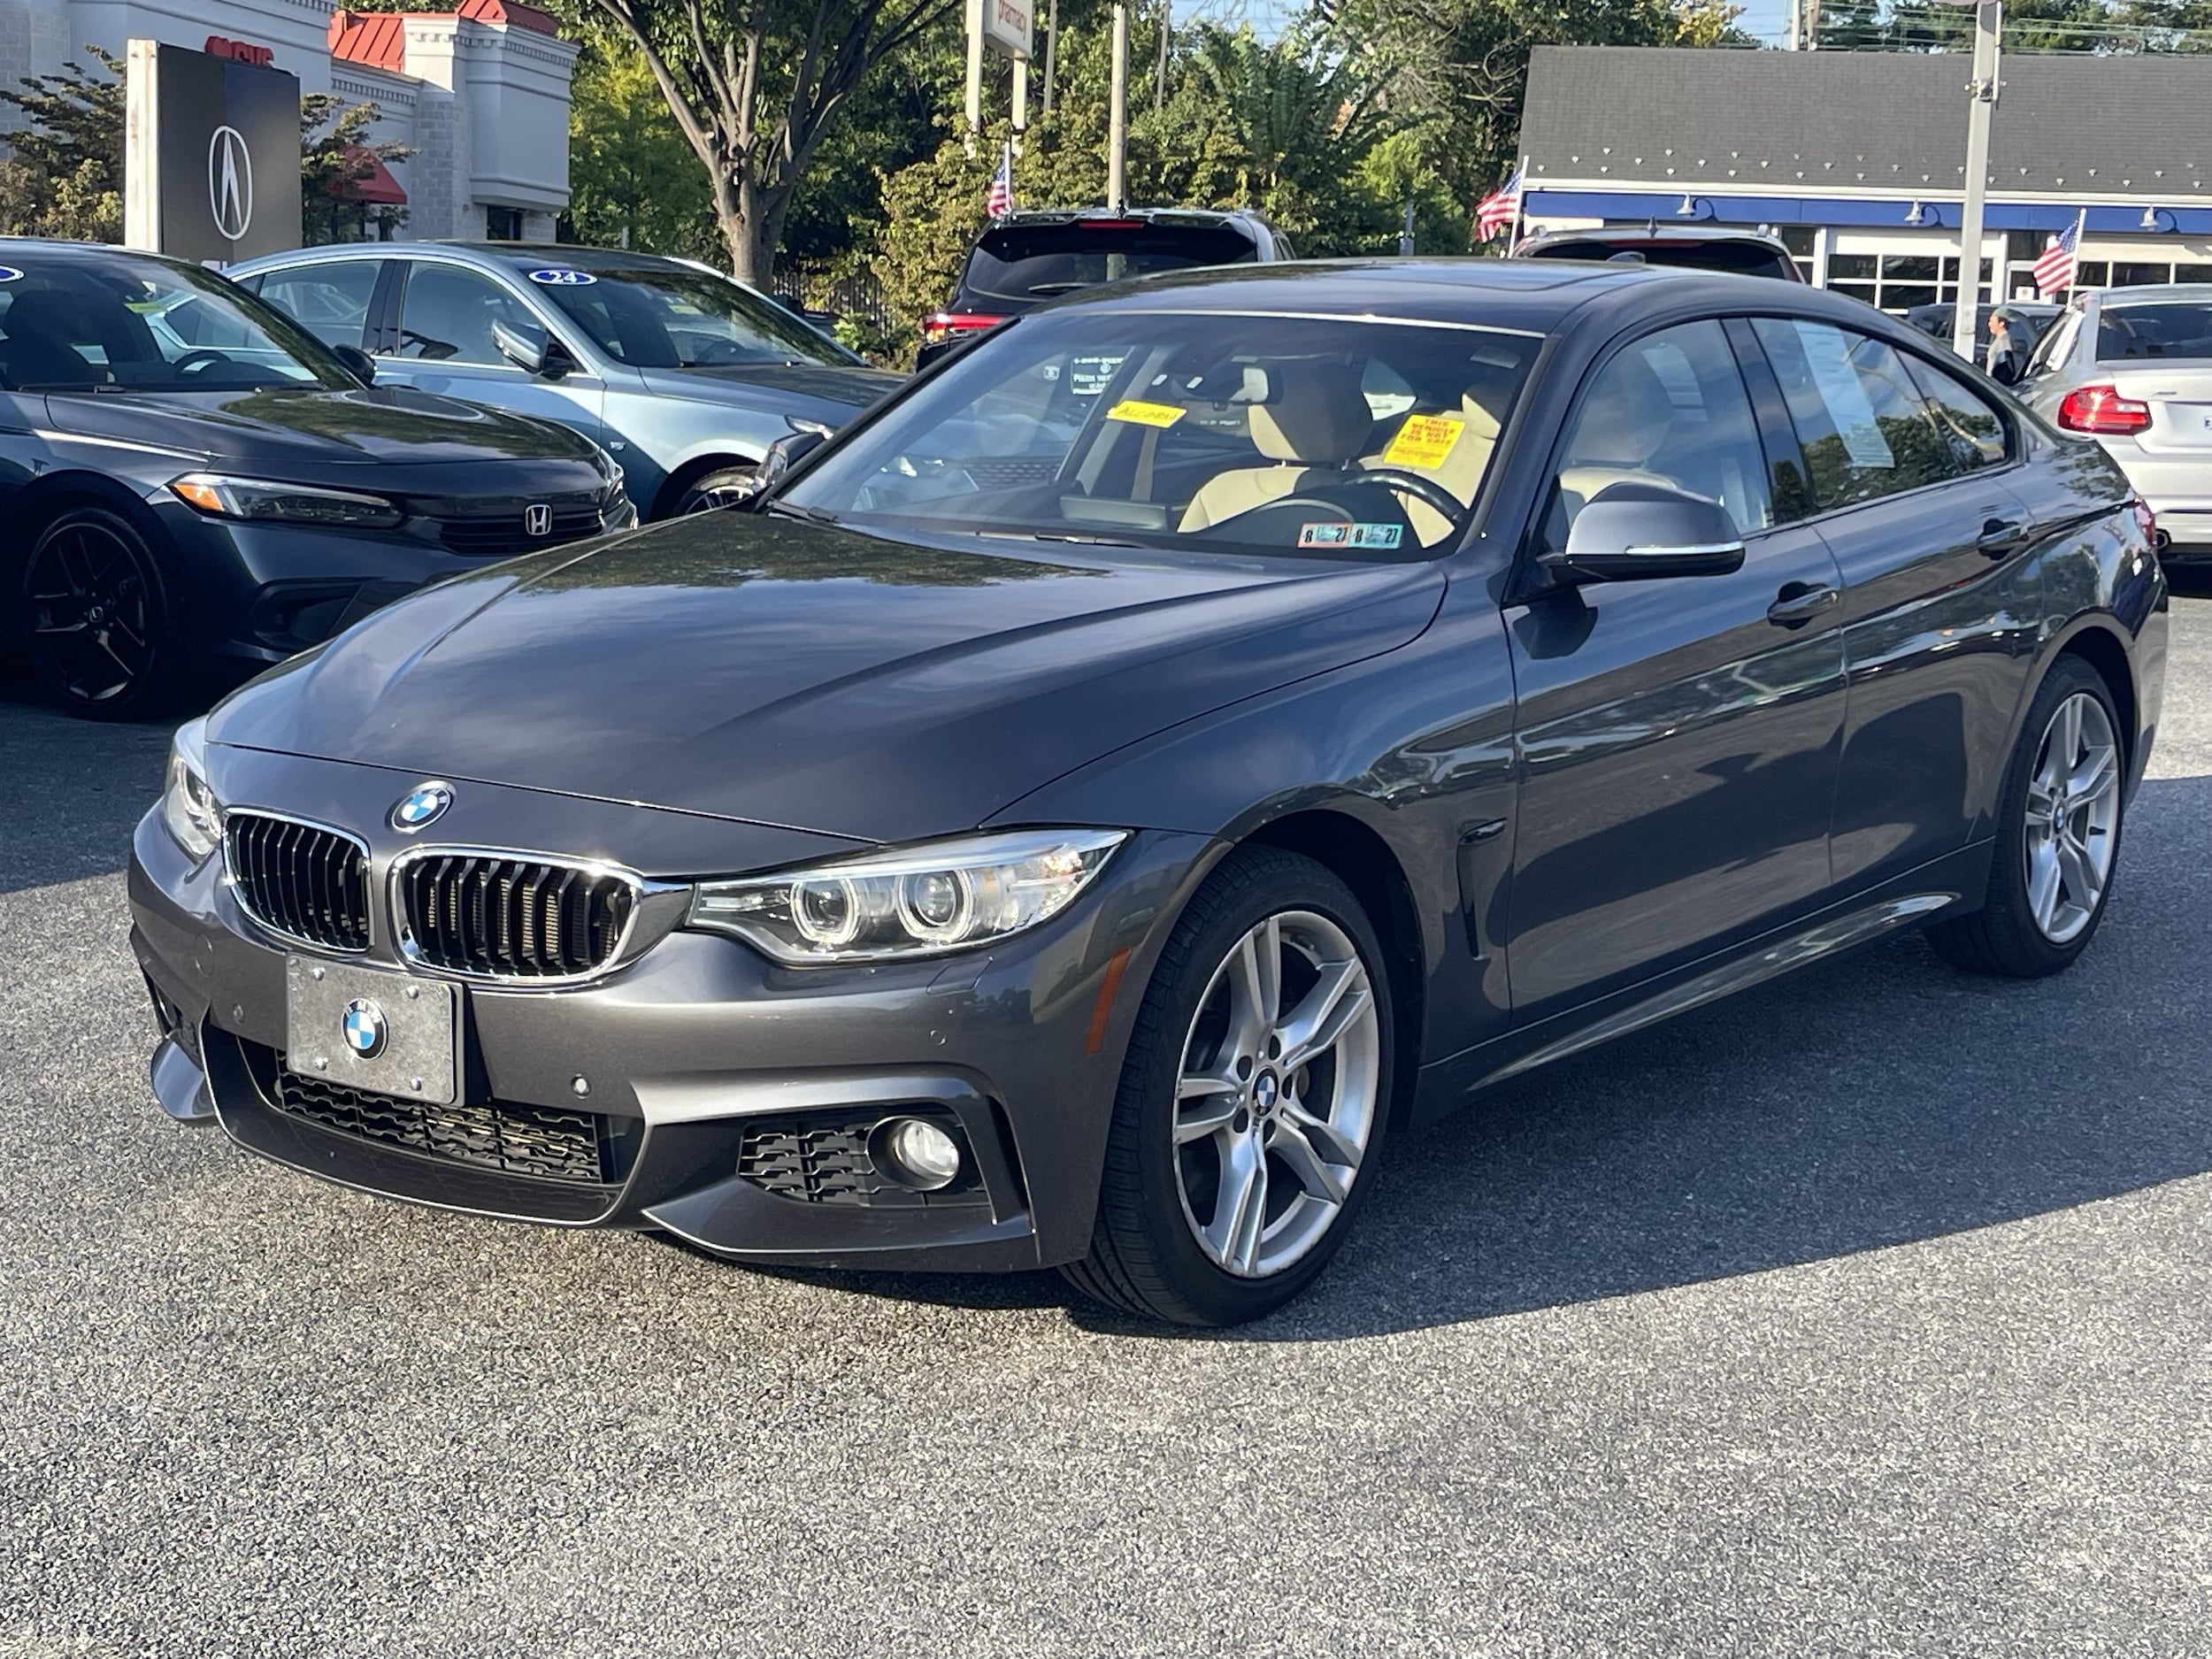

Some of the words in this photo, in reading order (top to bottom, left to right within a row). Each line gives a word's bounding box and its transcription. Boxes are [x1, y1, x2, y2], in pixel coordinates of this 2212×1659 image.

[549, 271, 578, 283] 24
[1304, 529, 1313, 543] 8
[1355, 528, 1363, 543] 8
